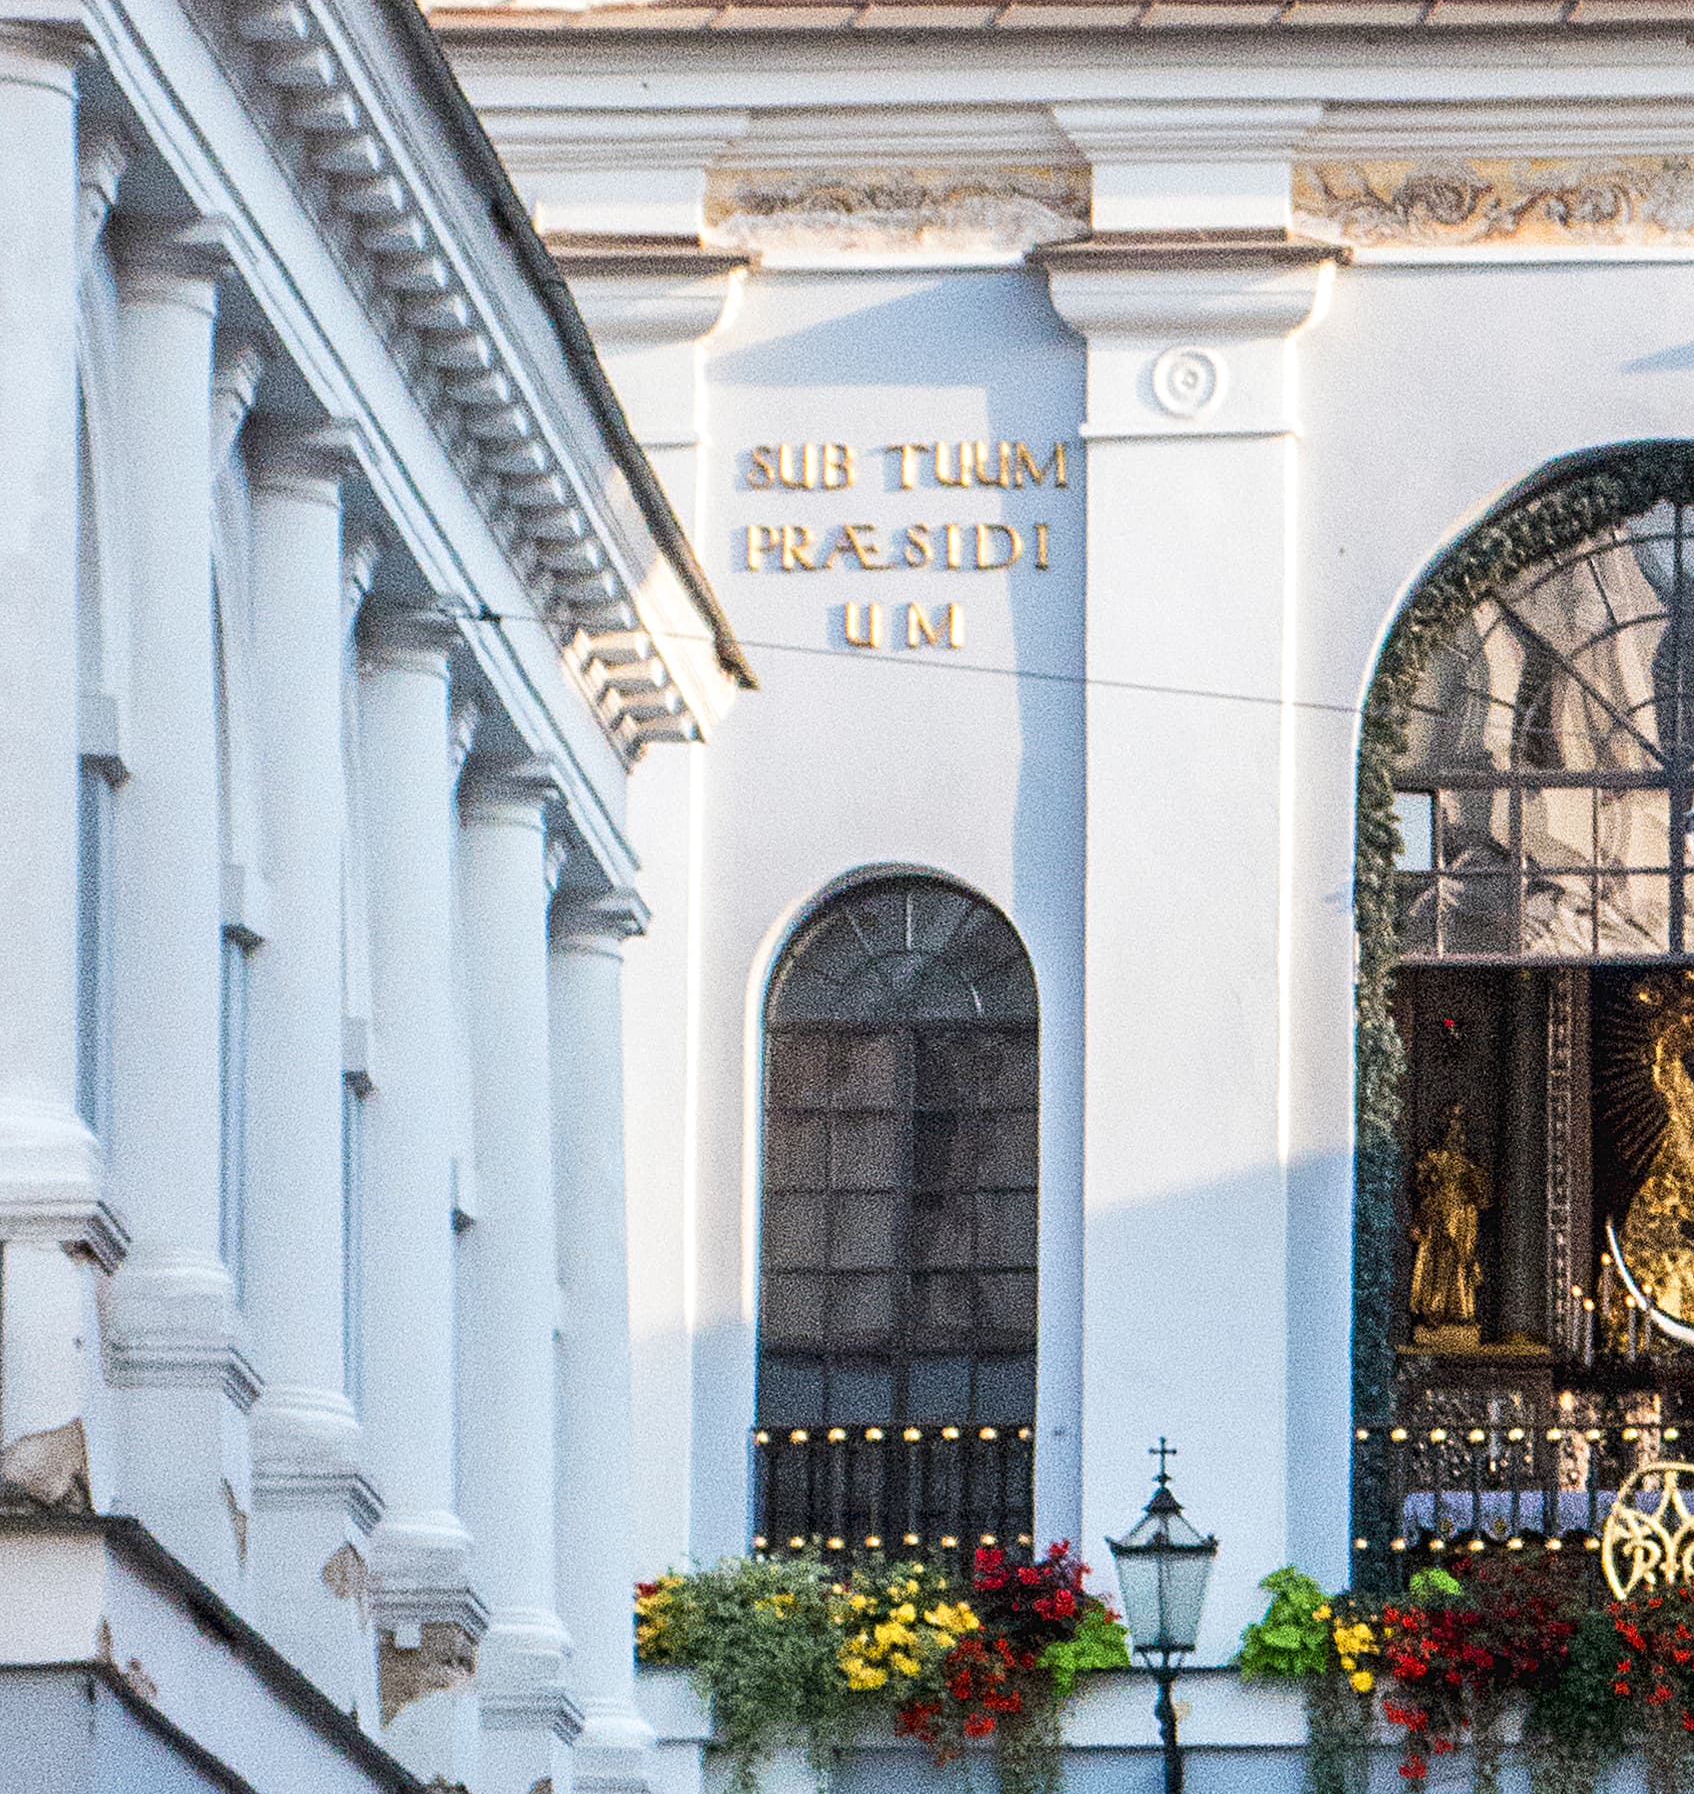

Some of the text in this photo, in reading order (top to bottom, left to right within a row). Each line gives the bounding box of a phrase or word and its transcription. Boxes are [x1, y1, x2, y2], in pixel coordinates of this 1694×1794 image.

[747, 441, 1068, 490] SUB TUUM
[746, 522, 1049, 571] PRÆSIDI
[844, 601, 965, 649] UM
